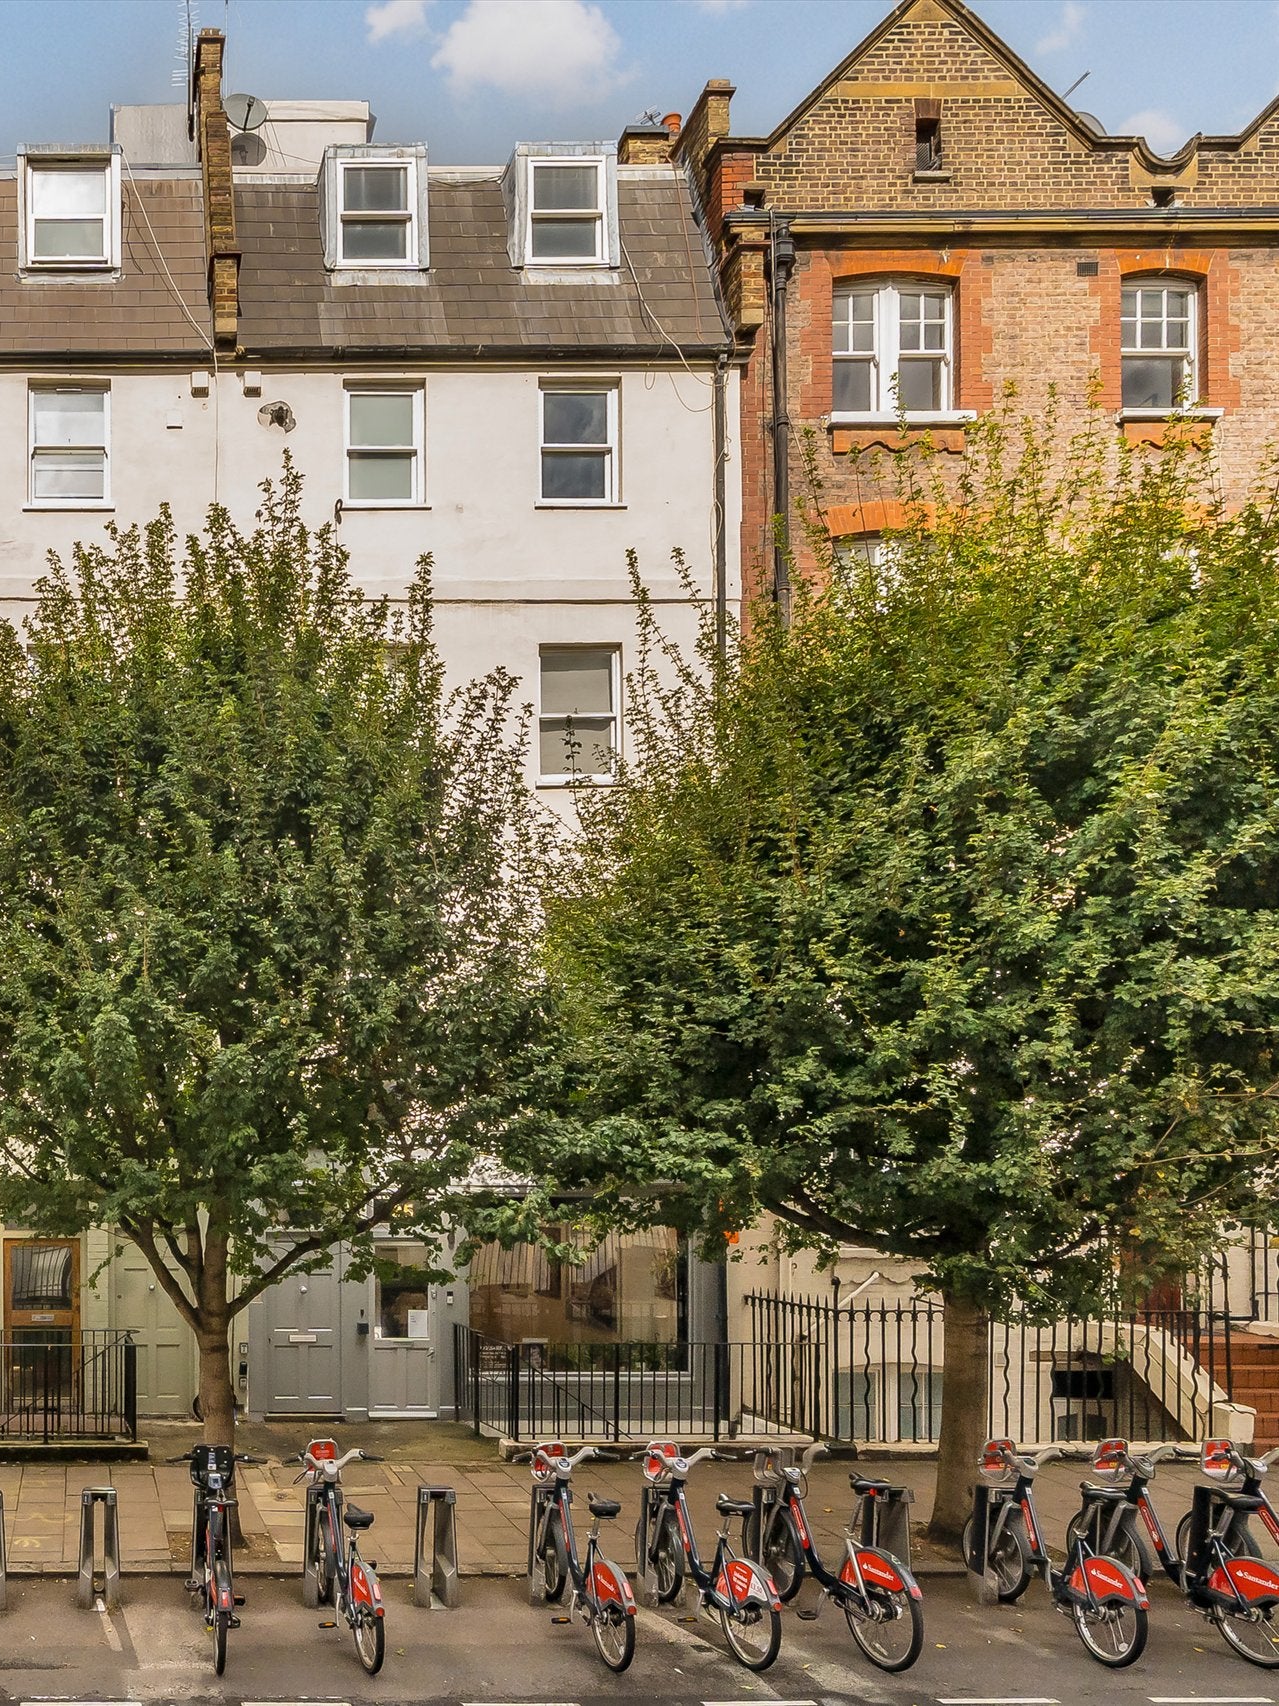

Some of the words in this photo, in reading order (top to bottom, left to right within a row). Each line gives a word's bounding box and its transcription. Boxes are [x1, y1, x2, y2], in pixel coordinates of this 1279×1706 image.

[868, 1563, 894, 1581] Santander
[1096, 1570, 1124, 1589] Santander
[1243, 1572, 1279, 1590] Santander
